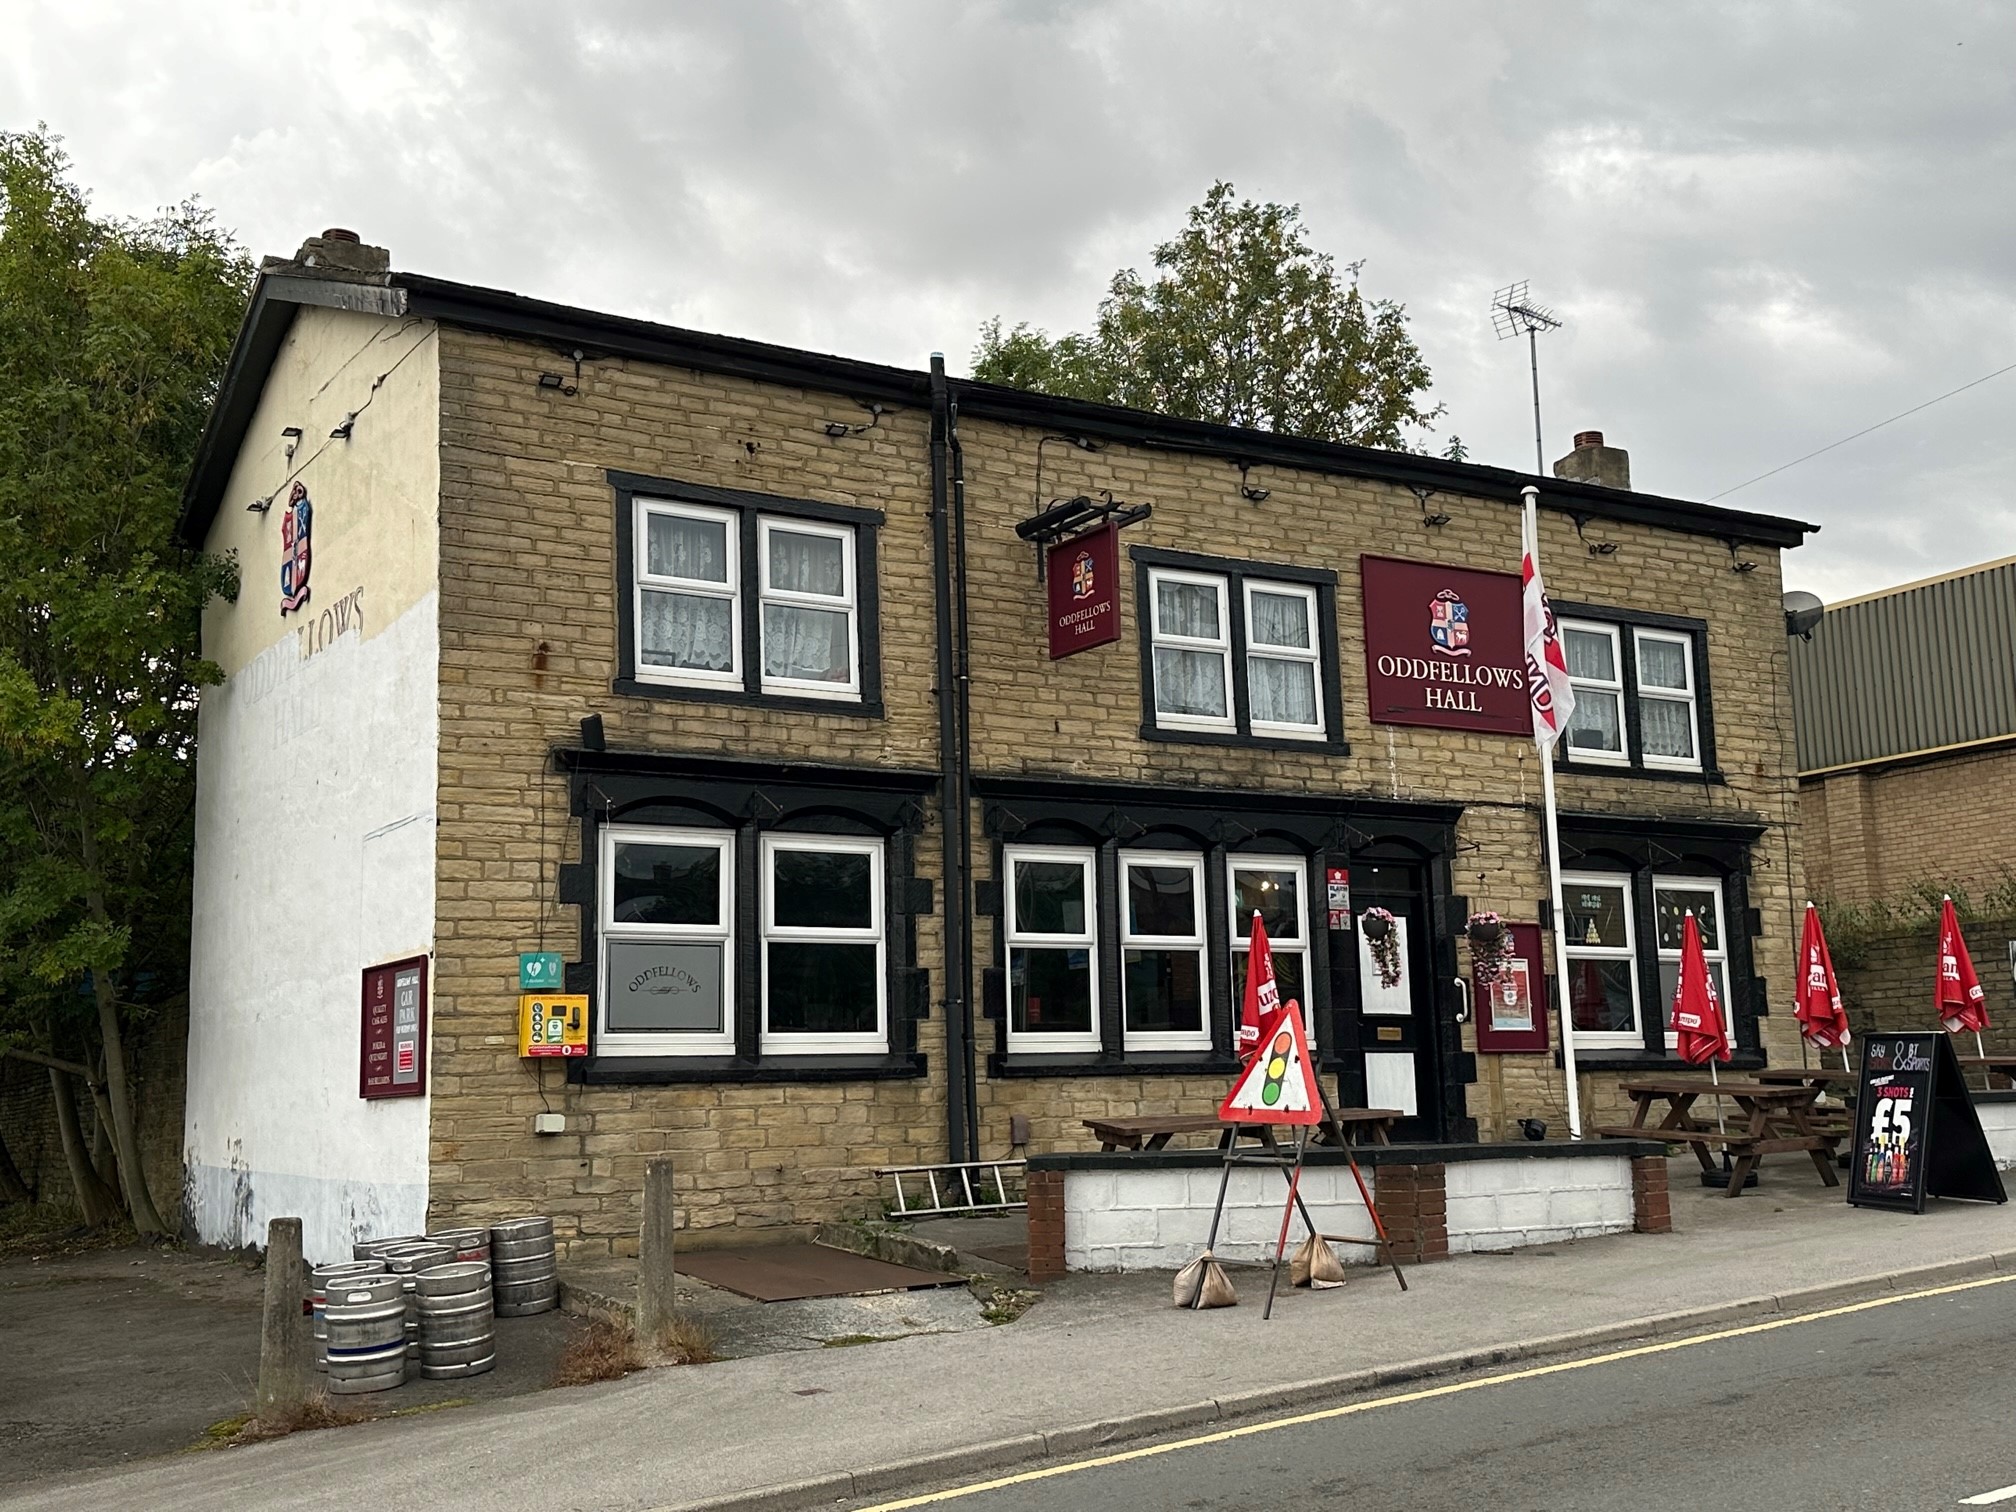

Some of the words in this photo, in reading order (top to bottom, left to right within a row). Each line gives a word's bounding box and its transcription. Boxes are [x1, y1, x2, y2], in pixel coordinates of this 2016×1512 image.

[1059, 601, 1111, 627] ODDFELLOWS
[1074, 620, 1096, 635] HALL
[1377, 655, 1523, 690] ODDFELLOWS
[1424, 687, 1483, 713] HALL
[628, 965, 702, 993] ODDFELLOWS
[401, 990, 413, 1006] CAR
[399, 1007, 416, 1023] PARK
[1870, 1043, 1886, 1058] SKY
[1908, 1043, 1919, 1057] BT
[1906, 1056, 1930, 1071] SPORTS
[1876, 1087, 1883, 1097] 3
[1883, 1087, 1909, 1098] SHOTS
[1870, 1098, 1912, 1145] £5
